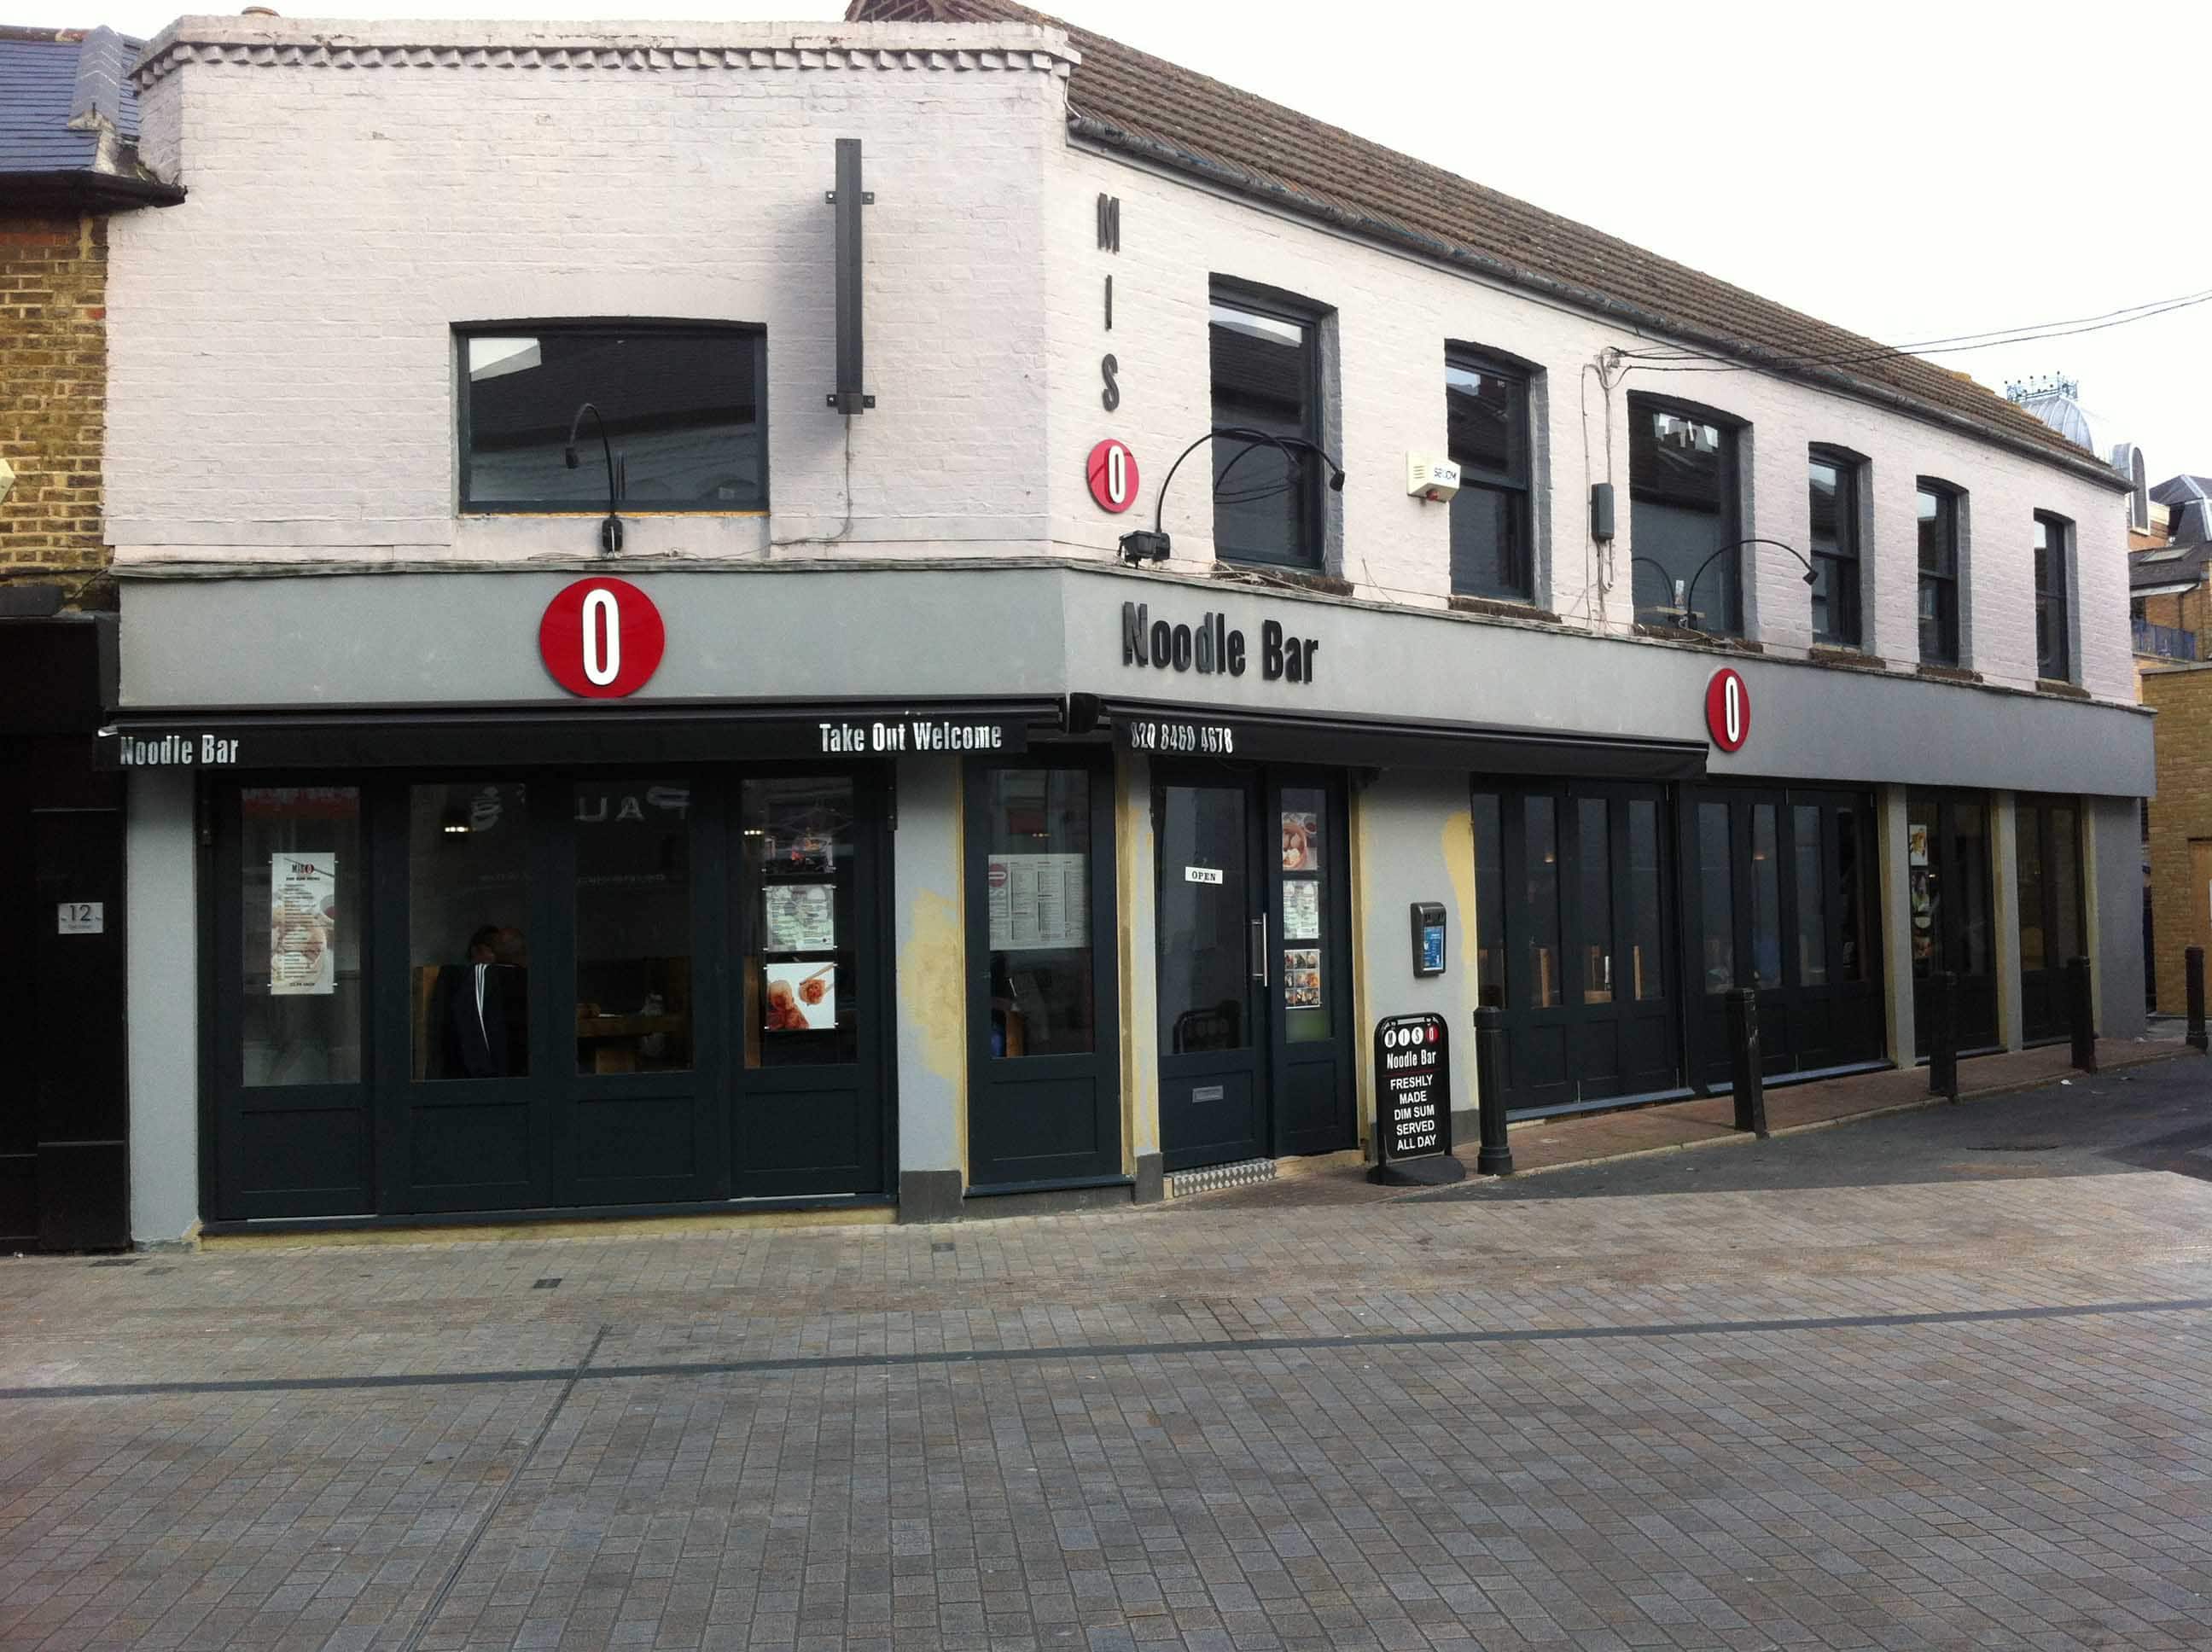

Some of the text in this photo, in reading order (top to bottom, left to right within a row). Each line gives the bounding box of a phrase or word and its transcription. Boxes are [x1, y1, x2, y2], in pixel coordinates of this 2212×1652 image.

[1123, 601, 1318, 683] Noodle Bar
[819, 722, 1003, 752] Take Out Welcome
[1131, 722, 1233, 753] 020 8460 4678
[120, 734, 239, 765] Noodle Bar
[1191, 870, 1215, 881] OPEN
[69, 905, 91, 922] 12
[1387, 1027, 1435, 1046] MISO
[1387, 1049, 1436, 1069] Noodle Bar
[1390, 1074, 1433, 1091] FRESHLY
[1400, 1091, 1428, 1104] MADE
[1394, 1104, 1435, 1120] DIM SUM
[1396, 1120, 1435, 1136] SERVED
[1397, 1134, 1437, 1151] ALL DAY
